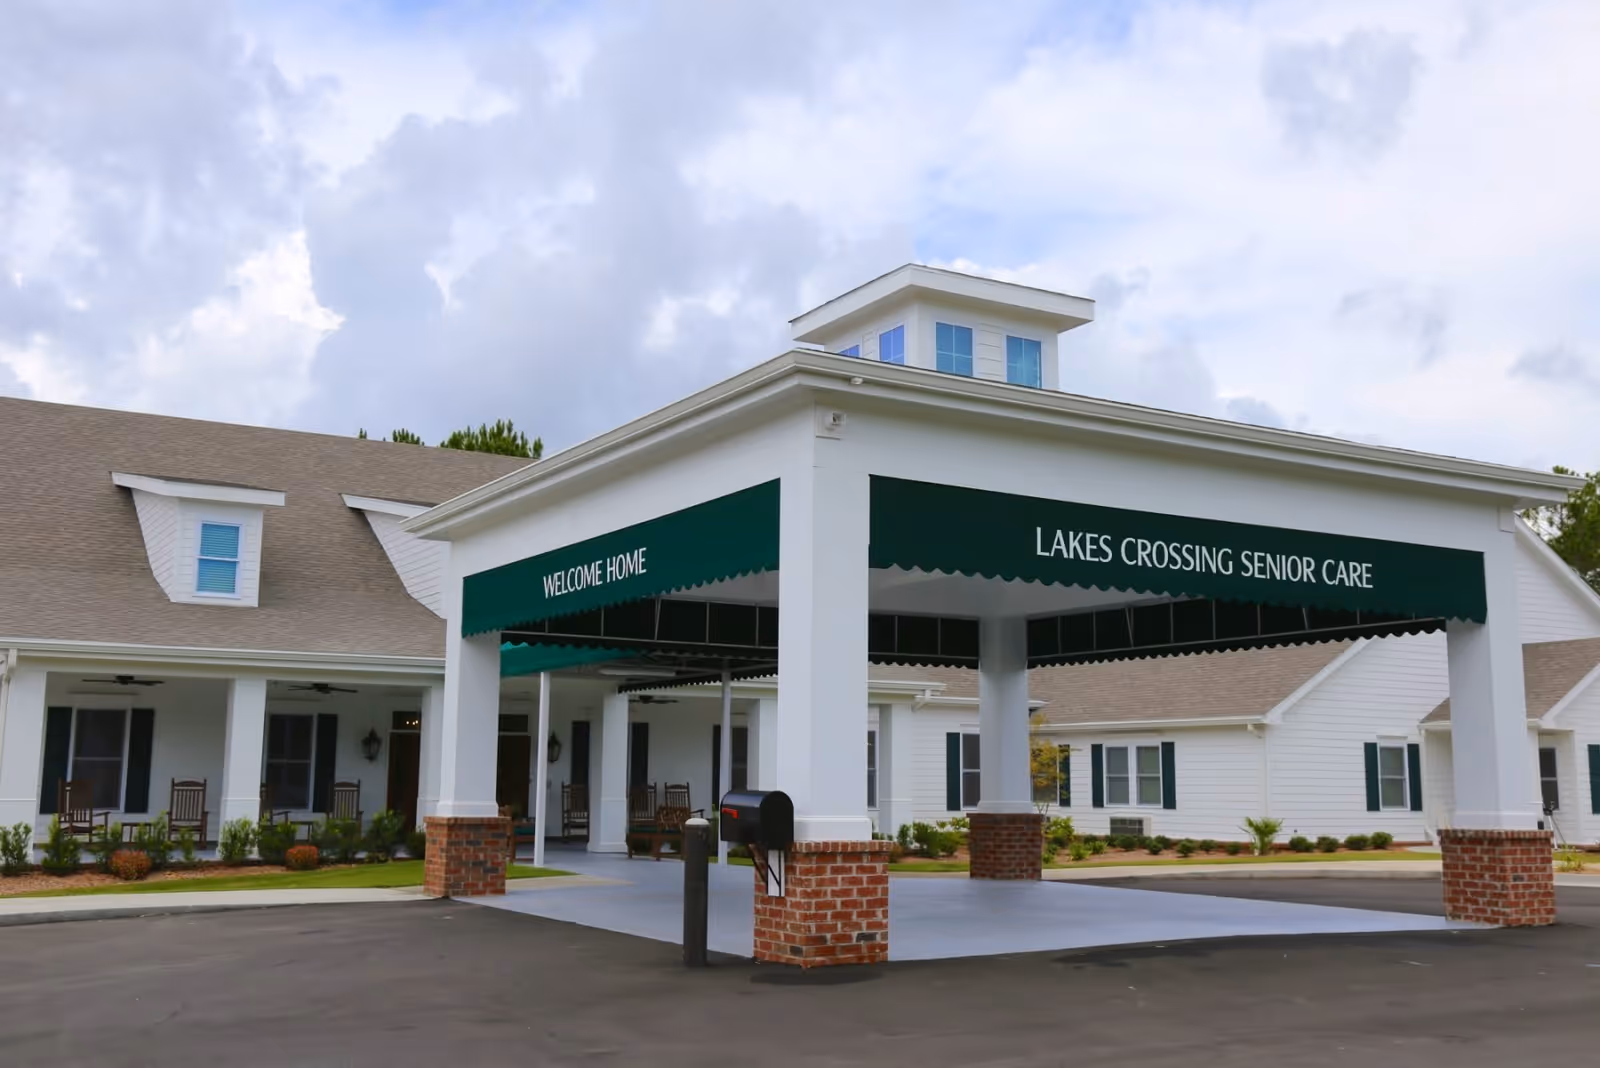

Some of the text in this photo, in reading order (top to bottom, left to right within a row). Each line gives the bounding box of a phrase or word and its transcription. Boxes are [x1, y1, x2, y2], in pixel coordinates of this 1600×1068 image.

[542, 547, 647, 598] WELCOME HOME
[1035, 525, 1374, 590] LAKES CROSSING SENIOR CARE
